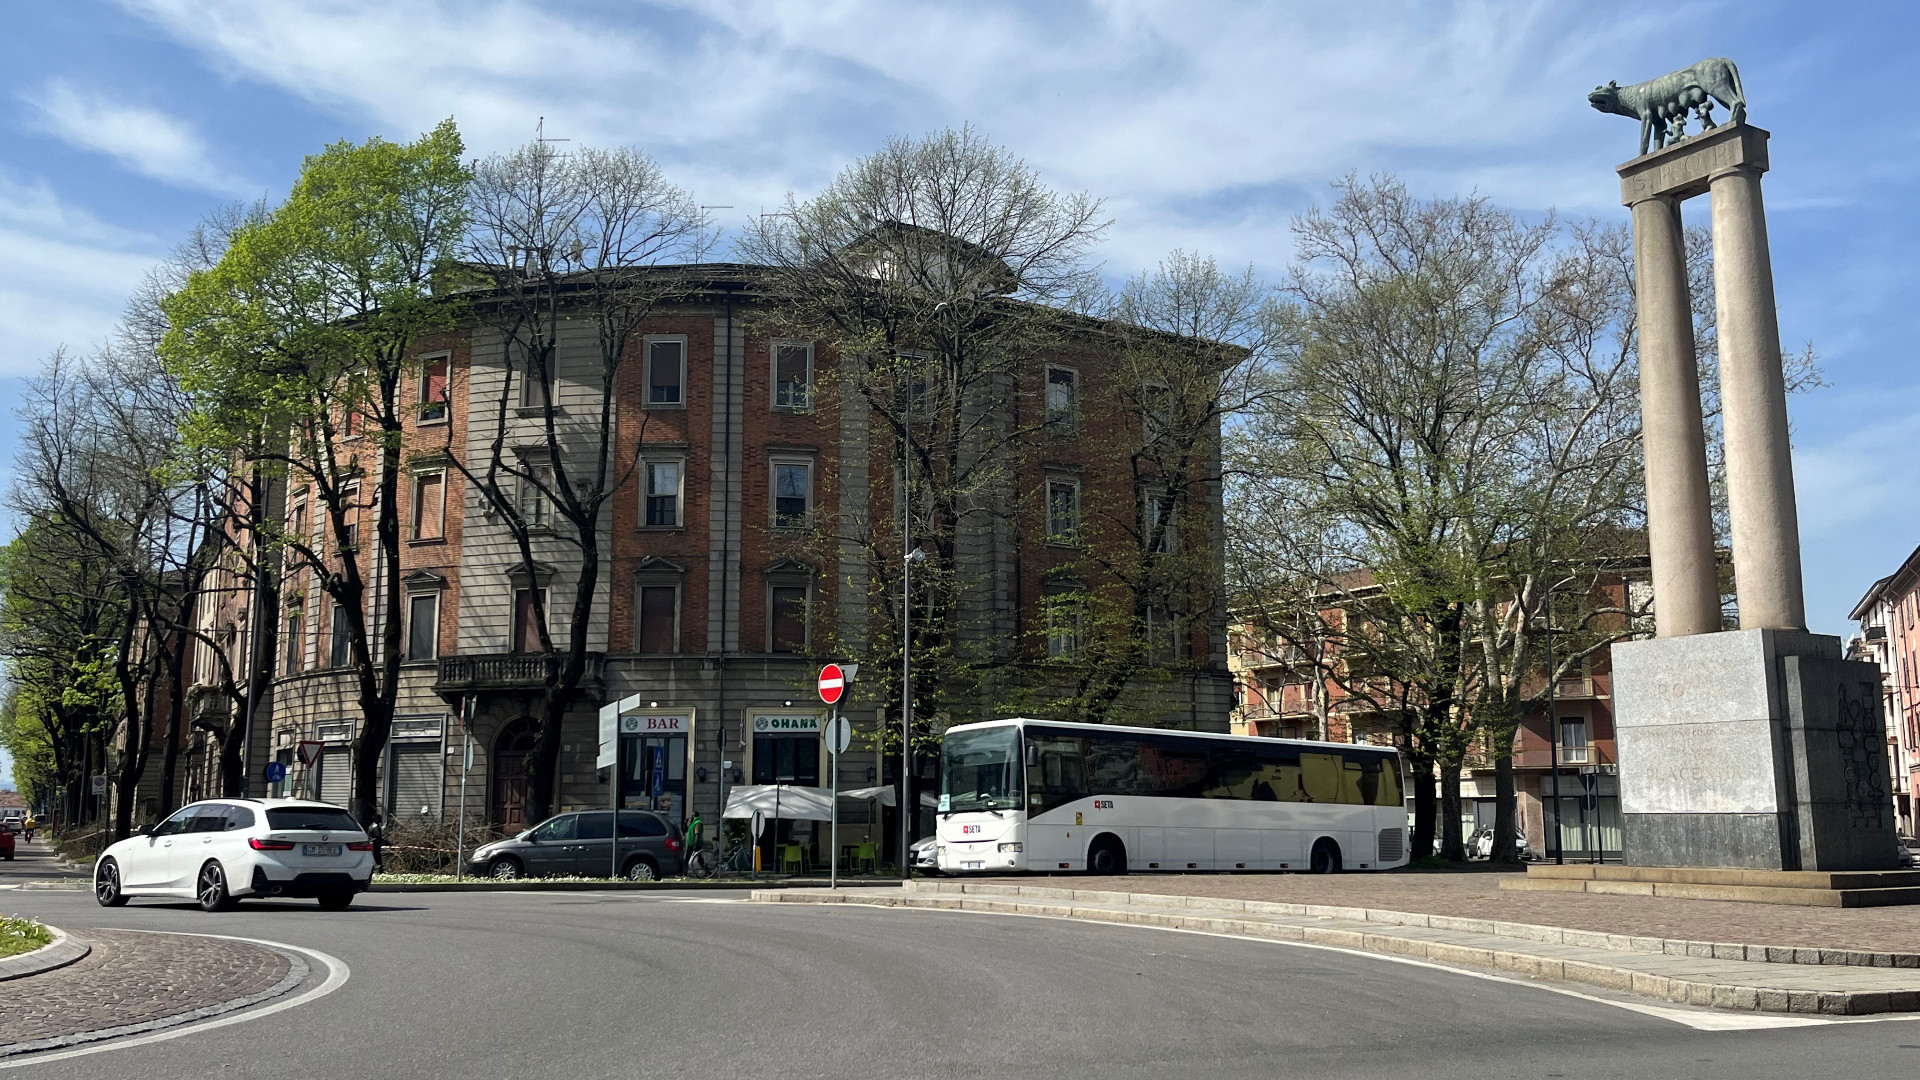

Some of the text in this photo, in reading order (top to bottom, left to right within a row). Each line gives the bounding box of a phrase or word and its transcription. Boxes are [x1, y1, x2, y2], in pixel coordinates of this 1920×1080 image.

[647, 718, 679, 729] BAR
[771, 718, 818, 729] OHANA
[1100, 800, 1114, 809] SETA
[968, 825, 981, 834] SETA
